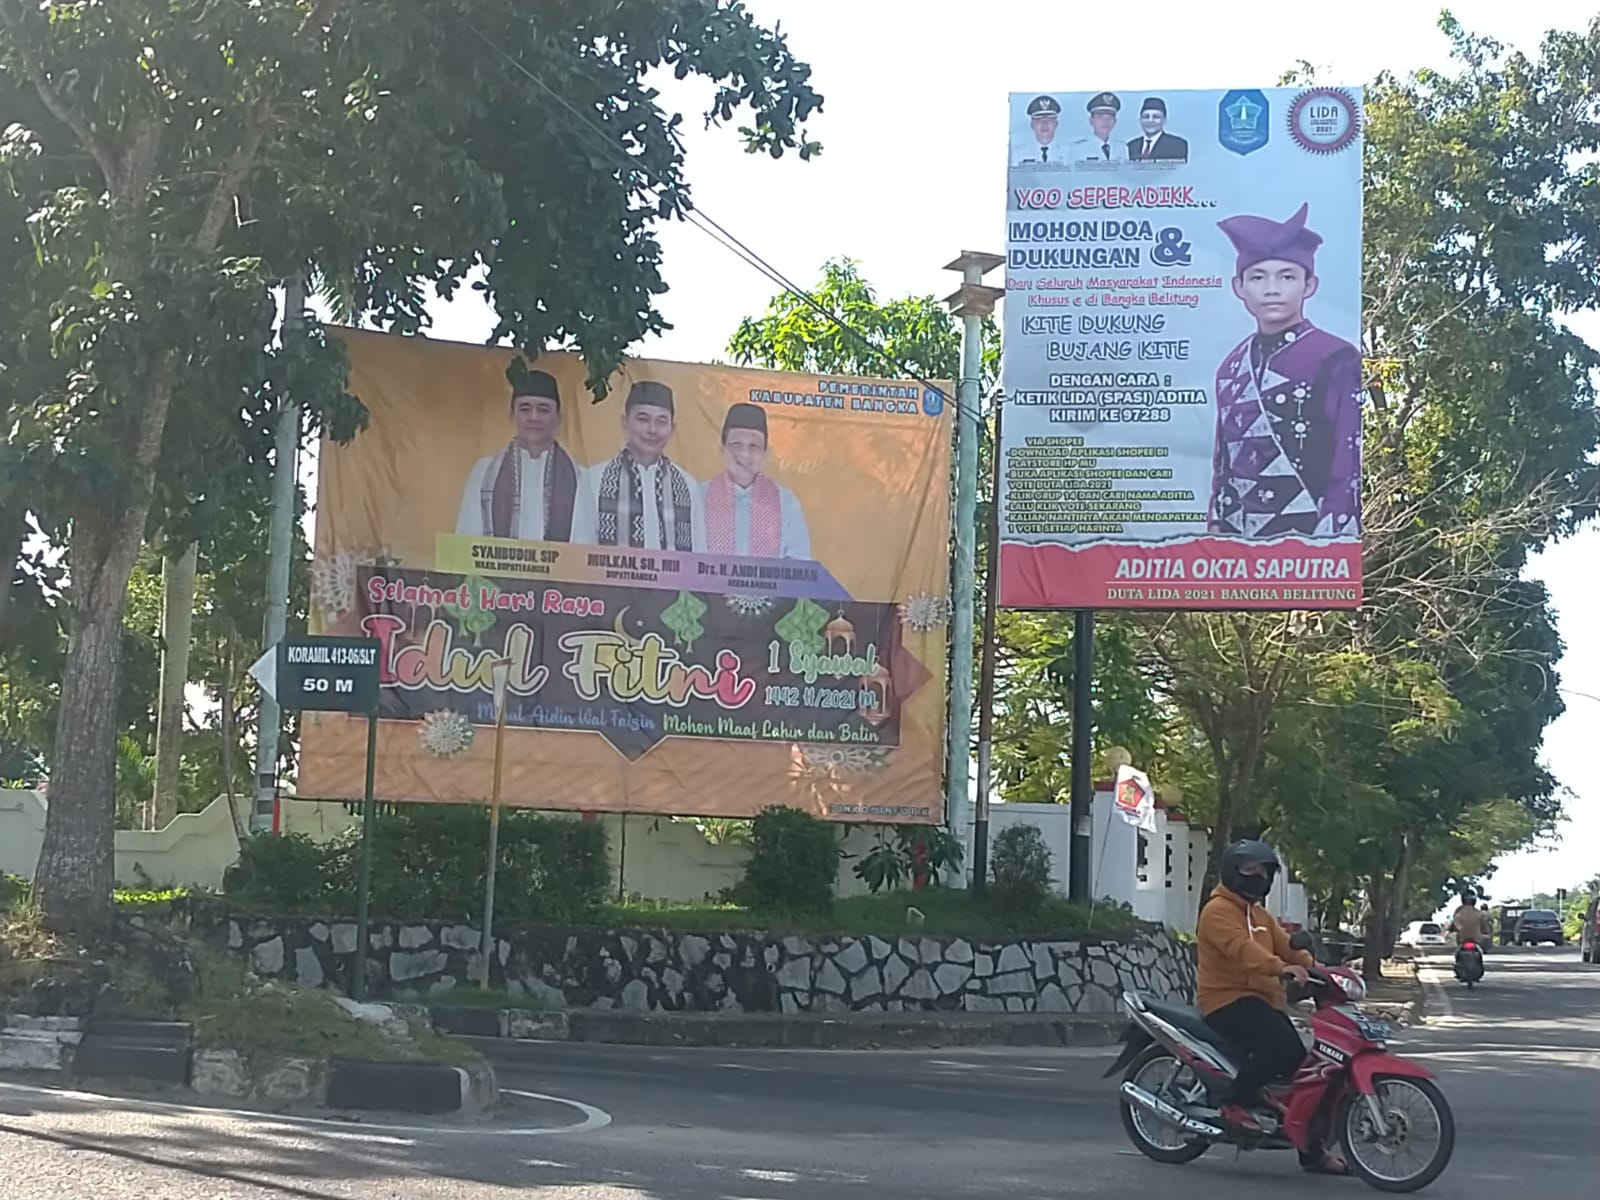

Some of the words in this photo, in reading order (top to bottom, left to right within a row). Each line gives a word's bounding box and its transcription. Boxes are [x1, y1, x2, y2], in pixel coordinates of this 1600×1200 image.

[1310, 106, 1338, 118] LIDA
[1015, 188, 1061, 209] YOO
[1009, 221, 1098, 243] MOHON
[1102, 220, 1153, 240] DOA
[1151, 227, 1191, 267] &
[1008, 248, 1140, 269] DUKUNGAN
[1006, 277, 1033, 290] Dari
[1036, 277, 1083, 290] Seluruh
[1087, 276, 1159, 292] Masyarakat
[1162, 276, 1222, 289] Indonesia
[1028, 294, 1069, 307] Khusus
[1085, 293, 1098, 306] di
[1102, 293, 1146, 309] Bangka
[1149, 292, 1199, 309] Belitung
[1022, 315, 1073, 335] KITE
[1079, 314, 1166, 334] DUKUNG
[1047, 341, 1132, 361] BUJANG
[1138, 340, 1190, 360] KITE
[1050, 373, 1114, 388] DENGAN
[1115, 373, 1158, 387] CARA
[818, 380, 918, 399] PEMERINTAH
[750, 389, 844, 409] KABUPATEN
[851, 398, 918, 414] BANGKA
[1014, 391, 1058, 405] KETIK
[1061, 390, 1097, 405] LIDA
[1099, 390, 1153, 406] (SPASI)
[1154, 390, 1207, 404] ADITIA
[1050, 409, 1097, 423] KIRIM
[1099, 409, 1119, 422] KE
[1122, 409, 1170, 422] 97288
[1025, 437, 1043, 446] VIA
[1045, 437, 1084, 446] SHOPEE
[1070, 448, 1114, 457] APLIKASI
[1116, 447, 1155, 457] SHOPEE
[1156, 447, 1168, 457] DI
[1008, 459, 1062, 468] PLAYSTORE
[1063, 459, 1078, 468] HP
[1079, 459, 1097, 468] MU
[1039, 470, 1083, 479] APLIKASI
[1084, 469, 1123, 479] SHOPEE
[1124, 469, 1147, 479] DAN
[1149, 469, 1172, 479] CARI
[1008, 481, 1034, 490] VOTE
[1035, 481, 1062, 489] DUTA
[1063, 480, 1087, 489] LIDA
[1088, 480, 1112, 489] 2021
[1034, 491, 1062, 500] GRUP
[1064, 491, 1076, 500] 14
[1078, 491, 1100, 500] DAN
[1102, 491, 1125, 500] CARI
[1126, 490, 1159, 500] NAMA
[1160, 490, 1195, 500] ADITIA
[1035, 502, 1059, 511] KLIK
[1060, 502, 1086, 511] VOTE
[1087, 502, 1142, 511] SEKARANG
[1048, 513, 1099, 522] NANTINYA
[1101, 513, 1131, 522] AKAN
[1132, 512, 1207, 522] MENDAPATKAN
[1008, 524, 1014, 533] 1
[1016, 524, 1042, 533] VOTE
[1043, 524, 1077, 533] SETIAP
[1078, 524, 1123, 533] HARINYA
[540, 549, 559, 564] SIP
[698, 561, 718, 576] Drs.
[1115, 558, 1185, 579] ADITIA
[1191, 558, 1248, 579] OKTA
[1253, 557, 1350, 578] SAPUTRA
[367, 576, 471, 609] Selamat
[479, 587, 535, 612] Hari
[541, 590, 605, 616] Raya
[1107, 588, 1143, 600] DUTA
[1148, 588, 1181, 600] LIDA
[1184, 589, 1215, 600] 2021
[1221, 588, 1278, 600] BANGKA
[1284, 588, 1356, 600] BELITUNG
[288, 646, 330, 664] KORAMIL
[331, 647, 376, 665] 413-06/SLT
[361, 614, 549, 696] Idul
[558, 631, 756, 709] Fitri
[768, 640, 780, 673] 1
[789, 639, 877, 684] Syawal
[303, 678, 328, 692] 50
[335, 679, 354, 692] M
[765, 685, 799, 706] 1442
[477, 702, 525, 721] Mnal
[530, 704, 574, 724] Aidin
[578, 705, 607, 726] Wal
[663, 713, 715, 734] Mohon
[717, 716, 758, 739] Maaf
[762, 719, 803, 738] Lahir
[807, 722, 836, 740] dan
[838, 723, 880, 743] Batin
[1319, 1043, 1344, 1062] YAMAHA
